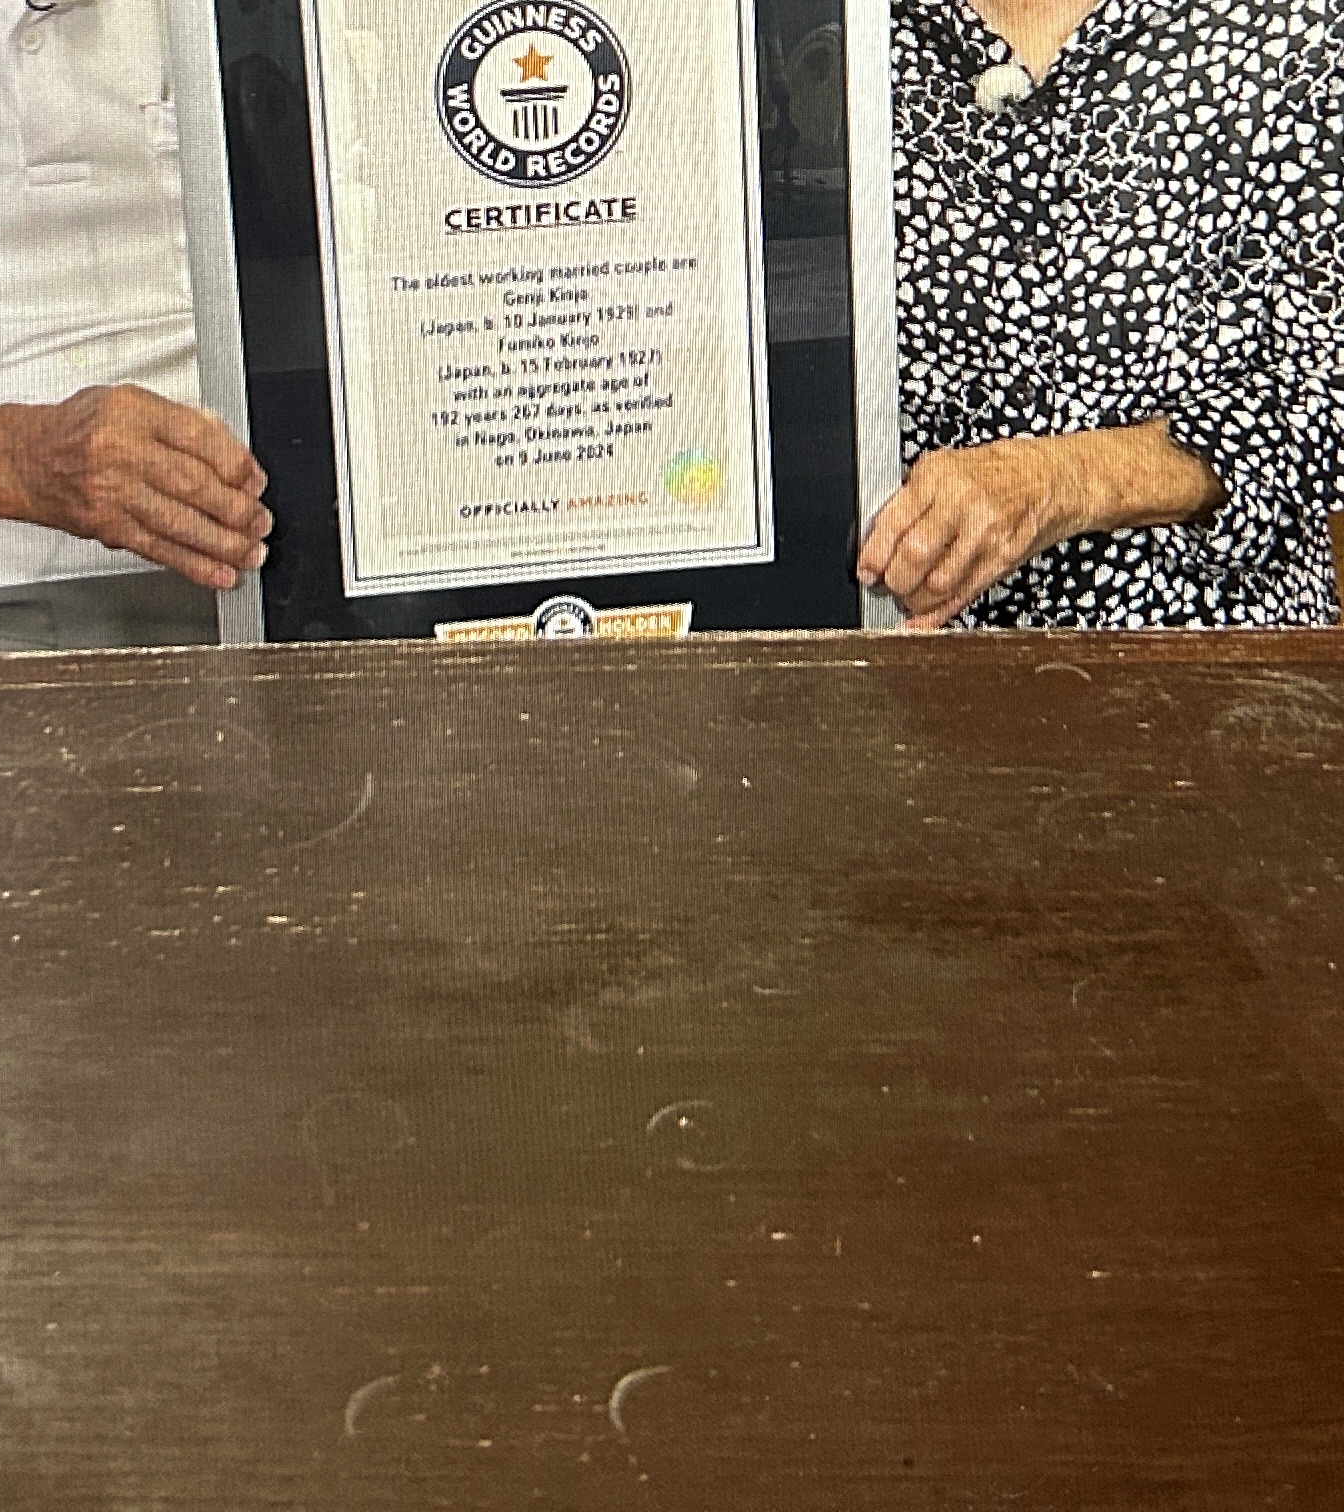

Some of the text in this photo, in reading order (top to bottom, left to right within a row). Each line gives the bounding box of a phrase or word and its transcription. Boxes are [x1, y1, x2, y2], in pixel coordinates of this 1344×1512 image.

[459, 4, 604, 61] GUINNESS
[446, 72, 621, 178] WORLD RECORDS
[444, 196, 637, 230] CERTIFICATE
[391, 256, 698, 291] The oldest working married couple are
[503, 289, 545, 307] Genji
[503, 313, 523, 329] 10
[527, 311, 591, 329] January
[645, 300, 674, 319] and
[520, 358, 539, 374] 15
[543, 354, 613, 373] February
[453, 371, 649, 402] with an aggregate age of
[431, 409, 459, 426] 192
[464, 410, 508, 429] years
[592, 400, 610, 413] as
[615, 391, 674, 411] verified
[455, 434, 469, 448] in
[603, 419, 653, 439] Japan
[494, 454, 515, 468] on
[532, 447, 572, 465] June
[576, 442, 615, 462] 2024
[459, 490, 649, 519] OFFICIALLY AMAZING
